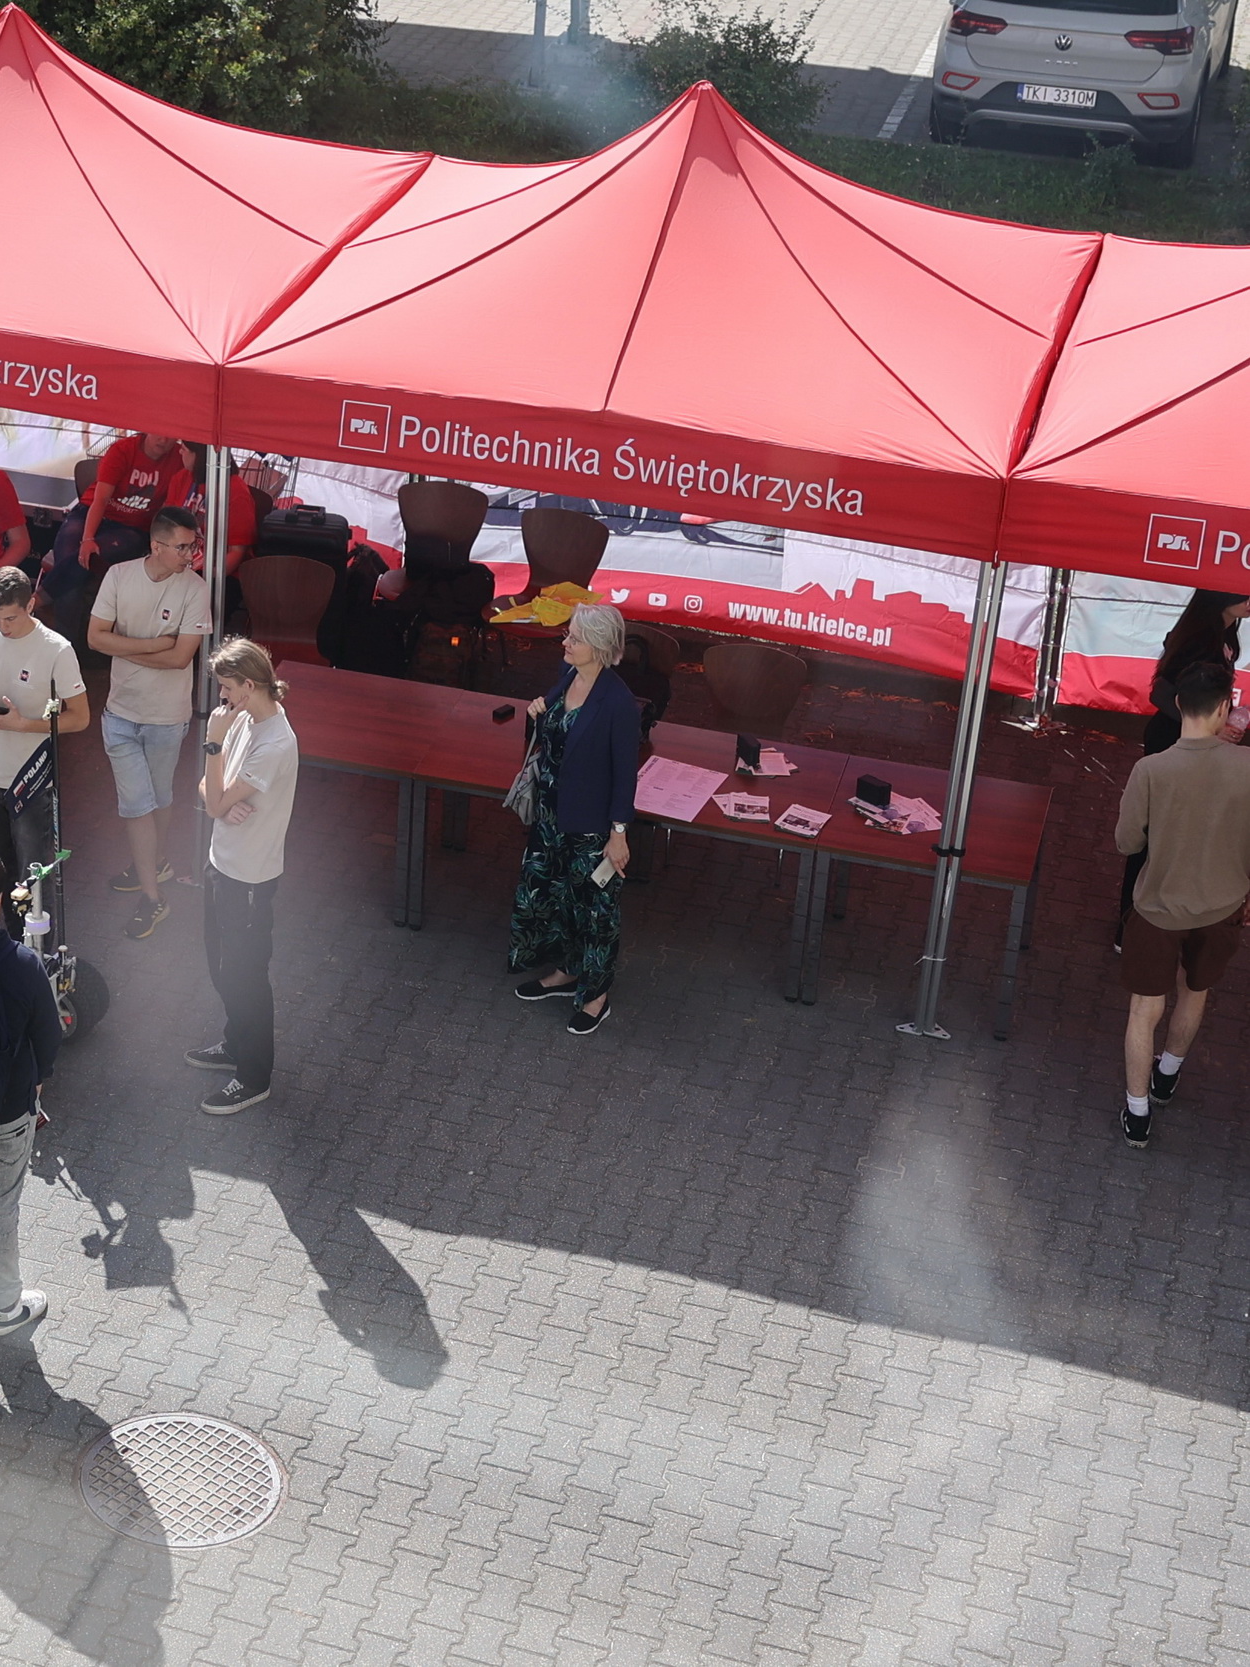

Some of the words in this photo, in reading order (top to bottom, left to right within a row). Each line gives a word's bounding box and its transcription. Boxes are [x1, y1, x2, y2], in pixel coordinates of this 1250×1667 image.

[1026, 86, 1047, 100] TKI
[1053, 88, 1095, 106] 3310M
[398, 415, 600, 476] Politechnika
[612, 438, 864, 516] Świętokrzyska
[728, 602, 892, 646] www.tu.kielce.pl
[23, 750, 48, 783] POLAND
